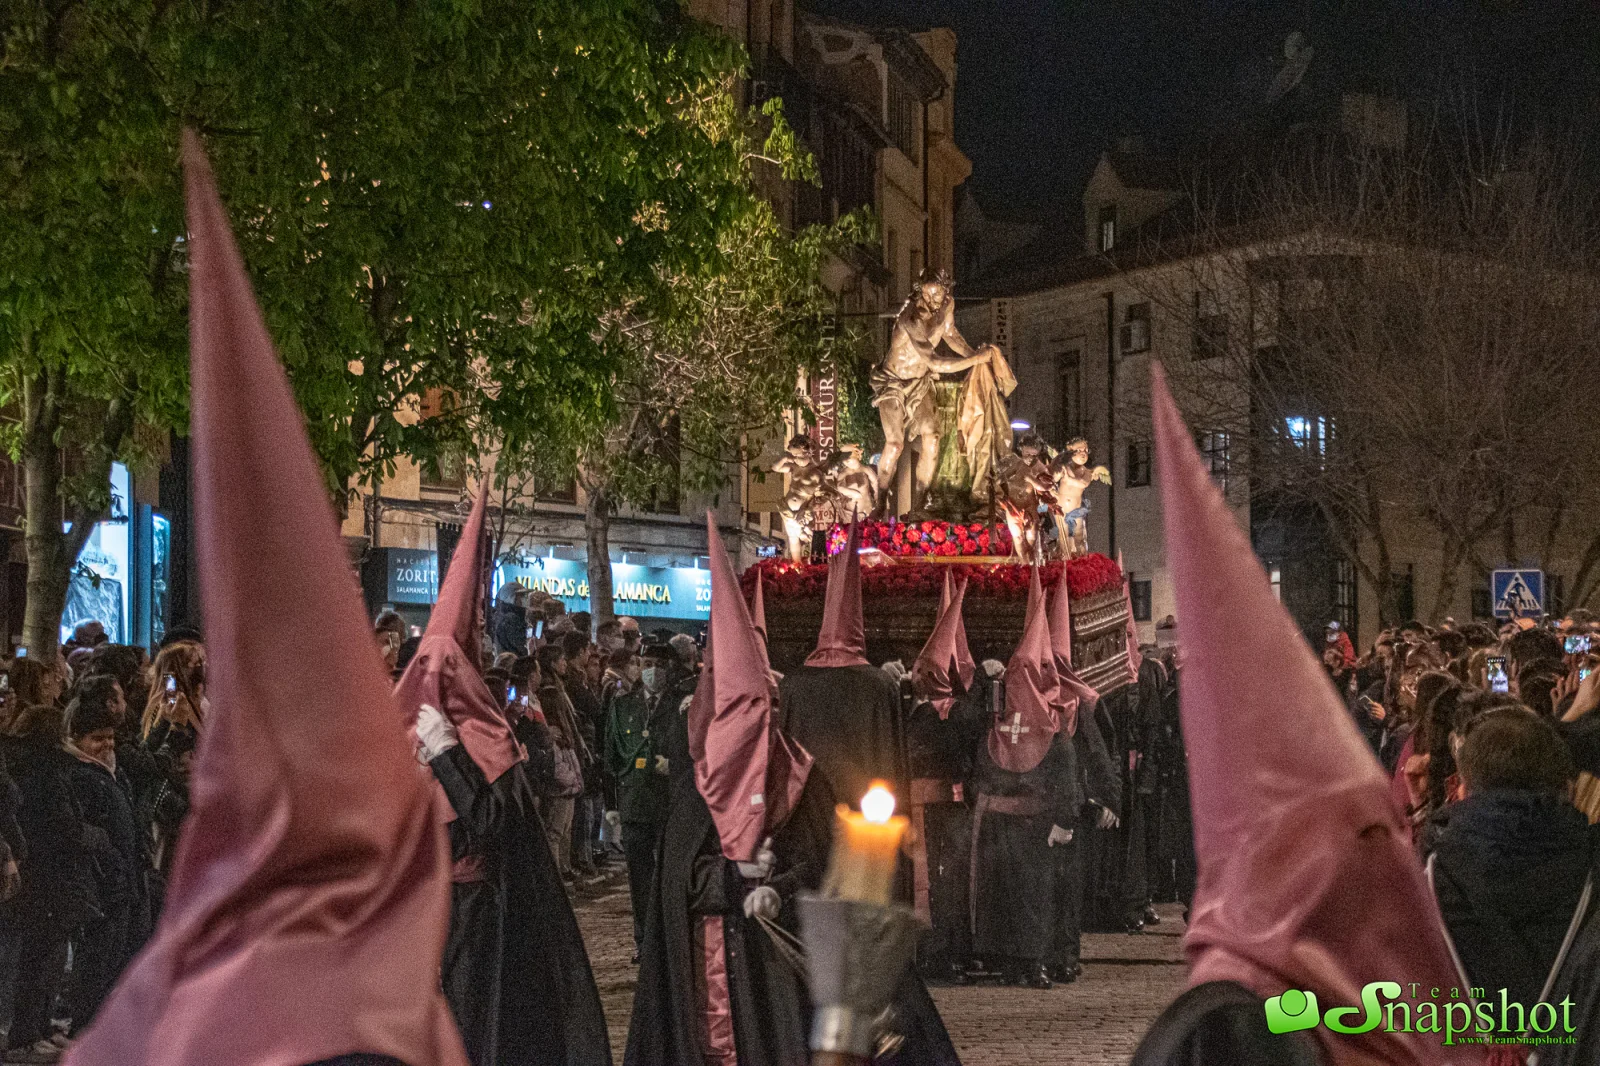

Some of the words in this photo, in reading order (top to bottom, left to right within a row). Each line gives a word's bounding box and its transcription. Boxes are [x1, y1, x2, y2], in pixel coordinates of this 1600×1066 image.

[396, 568, 439, 583] ZORIT
[396, 586, 429, 594] SALAMANCA
[516, 575, 576, 598] VIANDAS
[612, 582, 672, 603] AMANCA
